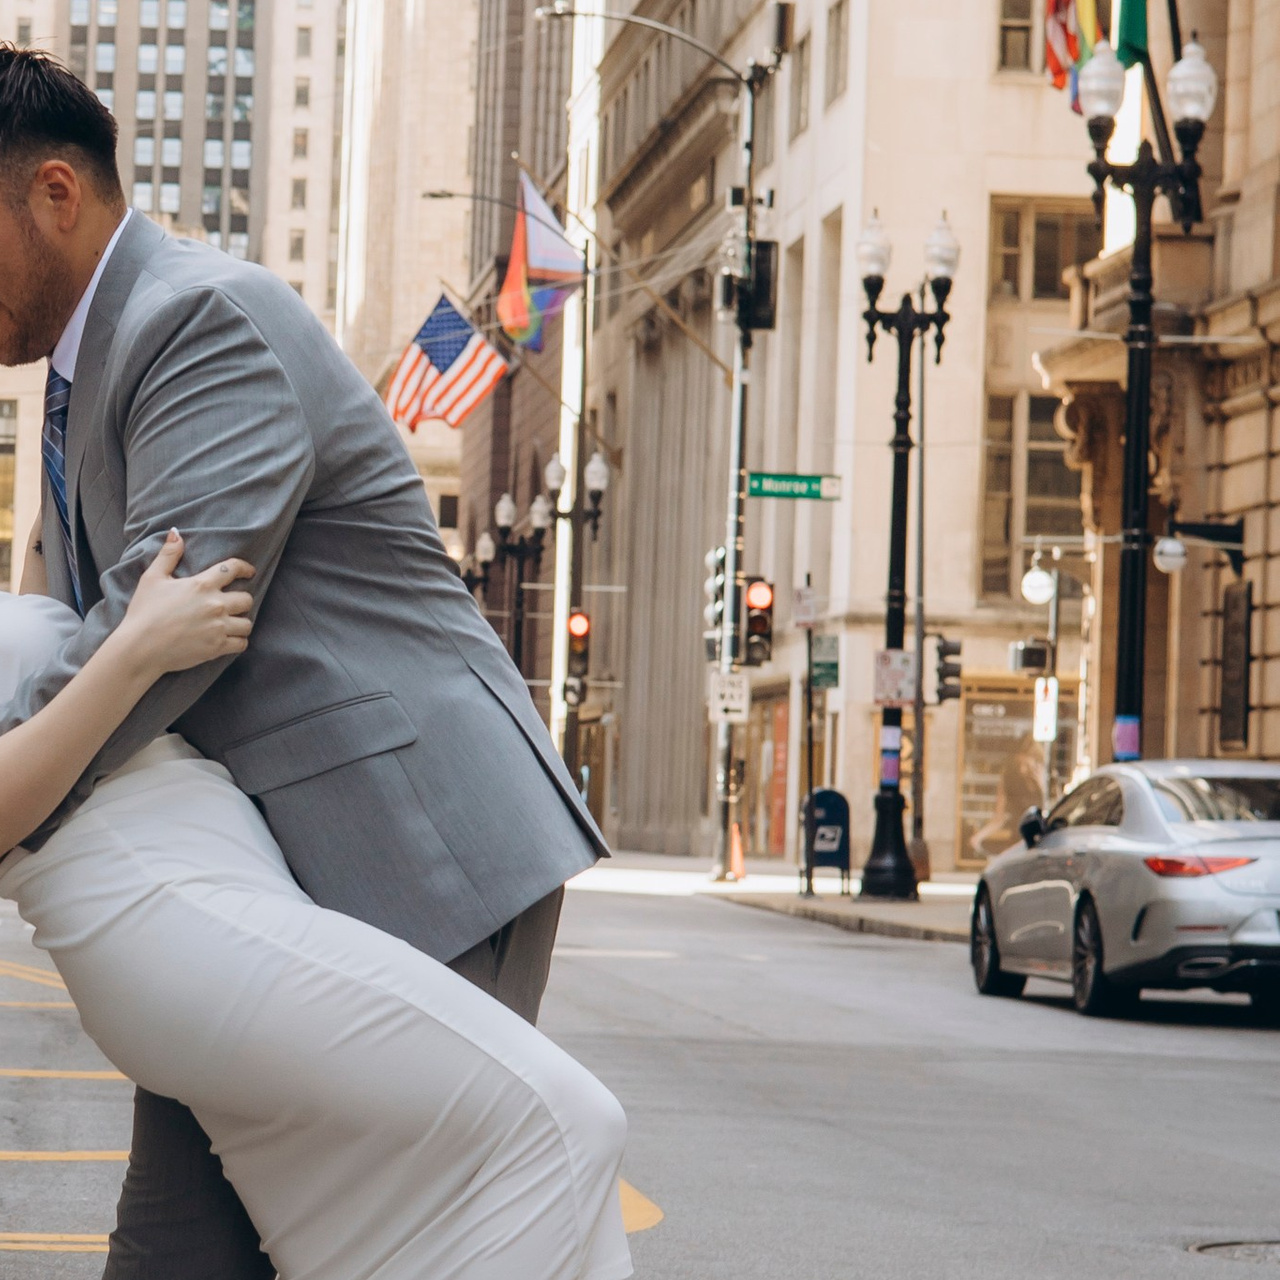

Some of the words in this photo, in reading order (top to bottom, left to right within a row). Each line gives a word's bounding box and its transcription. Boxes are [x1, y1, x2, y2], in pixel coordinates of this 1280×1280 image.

[762, 478, 808, 494] Monroe
[718, 679, 744, 689] ONE
[719, 692, 744, 701] WAY
